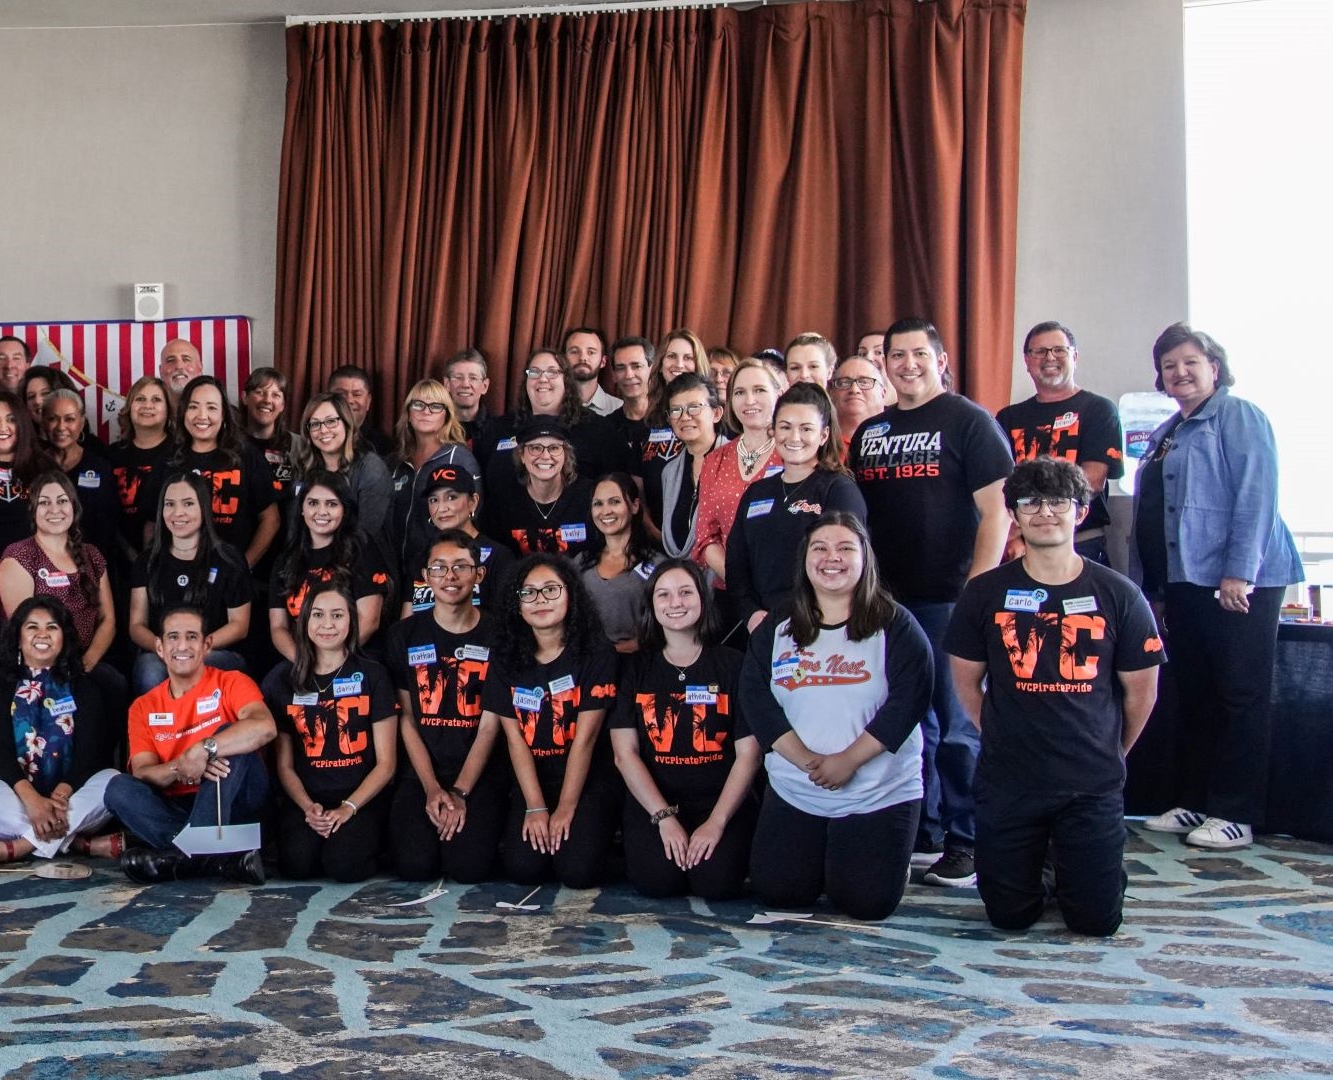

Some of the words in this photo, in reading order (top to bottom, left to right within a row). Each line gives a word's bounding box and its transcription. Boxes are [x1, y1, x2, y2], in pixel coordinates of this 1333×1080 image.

[859, 431, 942, 457] VENTURA
[433, 469, 456, 481] VC
[894, 464, 941, 478] 1925
[1008, 597, 1033, 607] Carlo
[994, 612, 1106, 680] VC
[415, 658, 490, 717] VC
[1015, 682, 1093, 693] #VCPiratePride
[286, 695, 370, 757] VC
[635, 693, 729, 752] VC
[654, 755, 724, 767] #VCPiratePride
